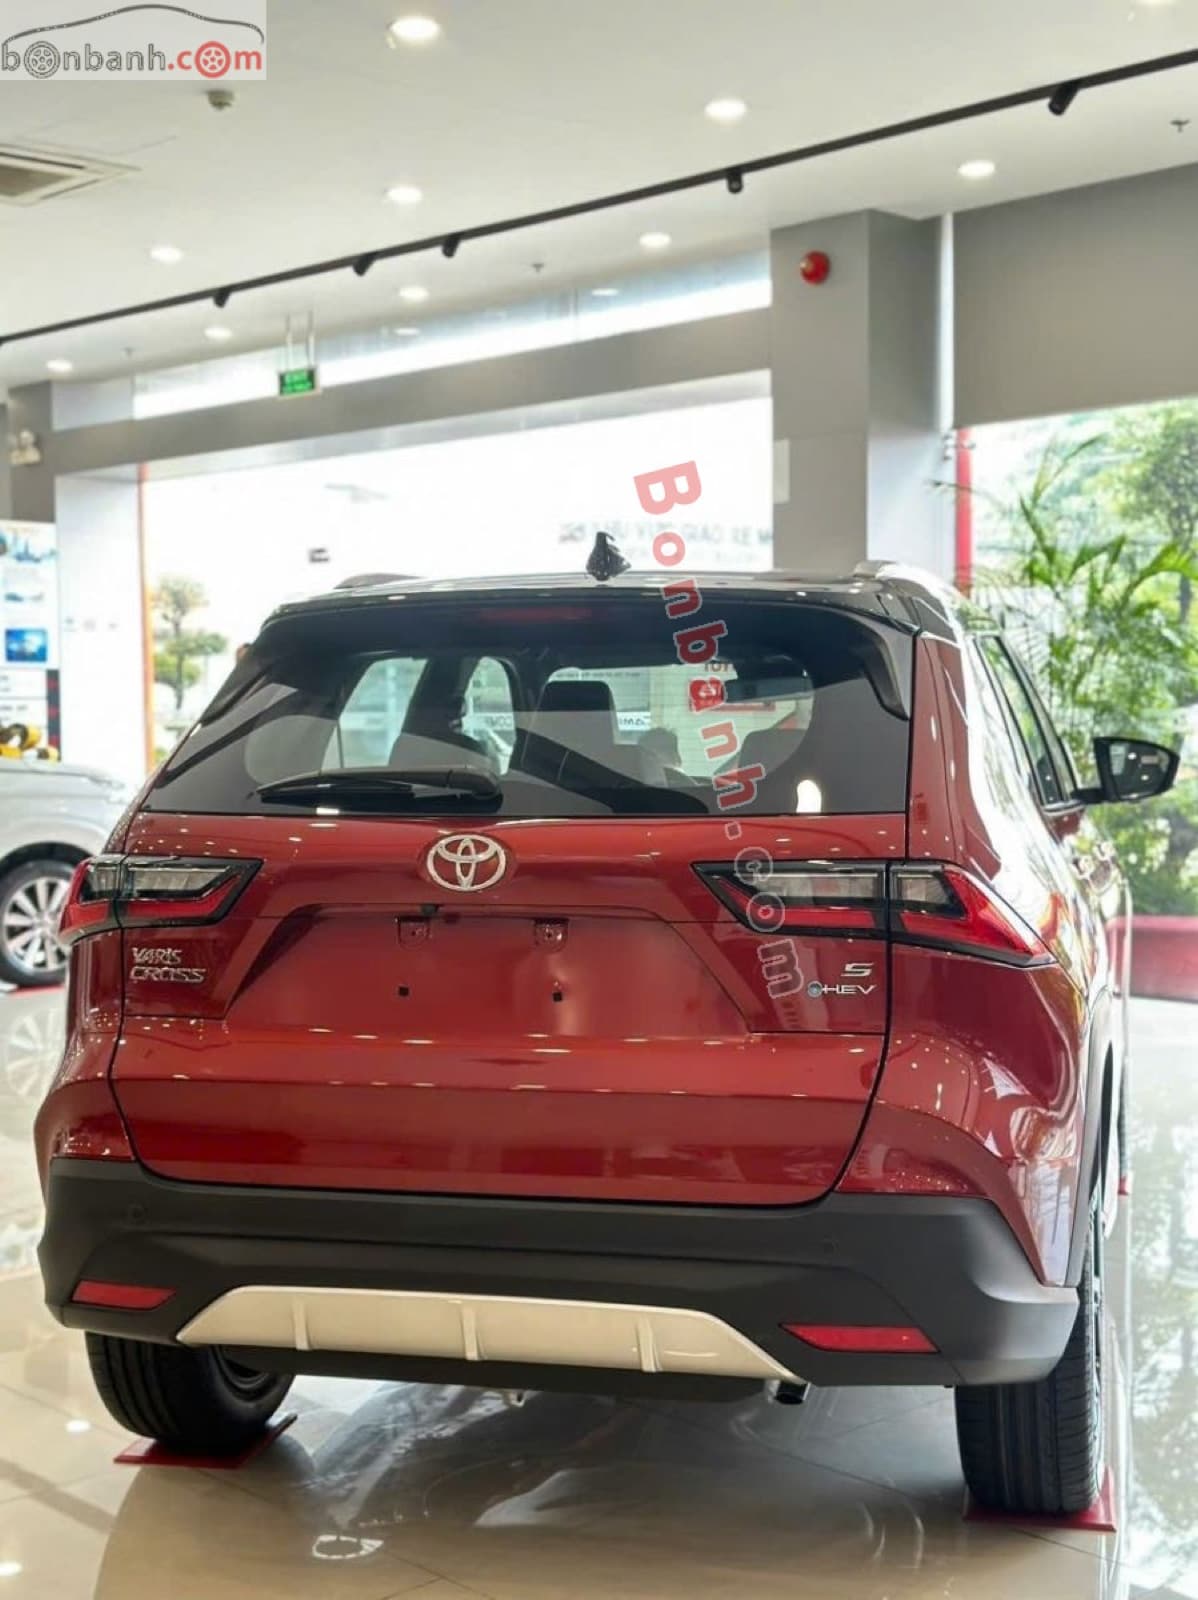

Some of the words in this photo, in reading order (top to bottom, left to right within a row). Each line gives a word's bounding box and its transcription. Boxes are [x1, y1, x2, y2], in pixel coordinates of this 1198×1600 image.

[129, 966, 206, 983] CROSS
[841, 962, 875, 977] S
[822, 984, 877, 995] HEV
